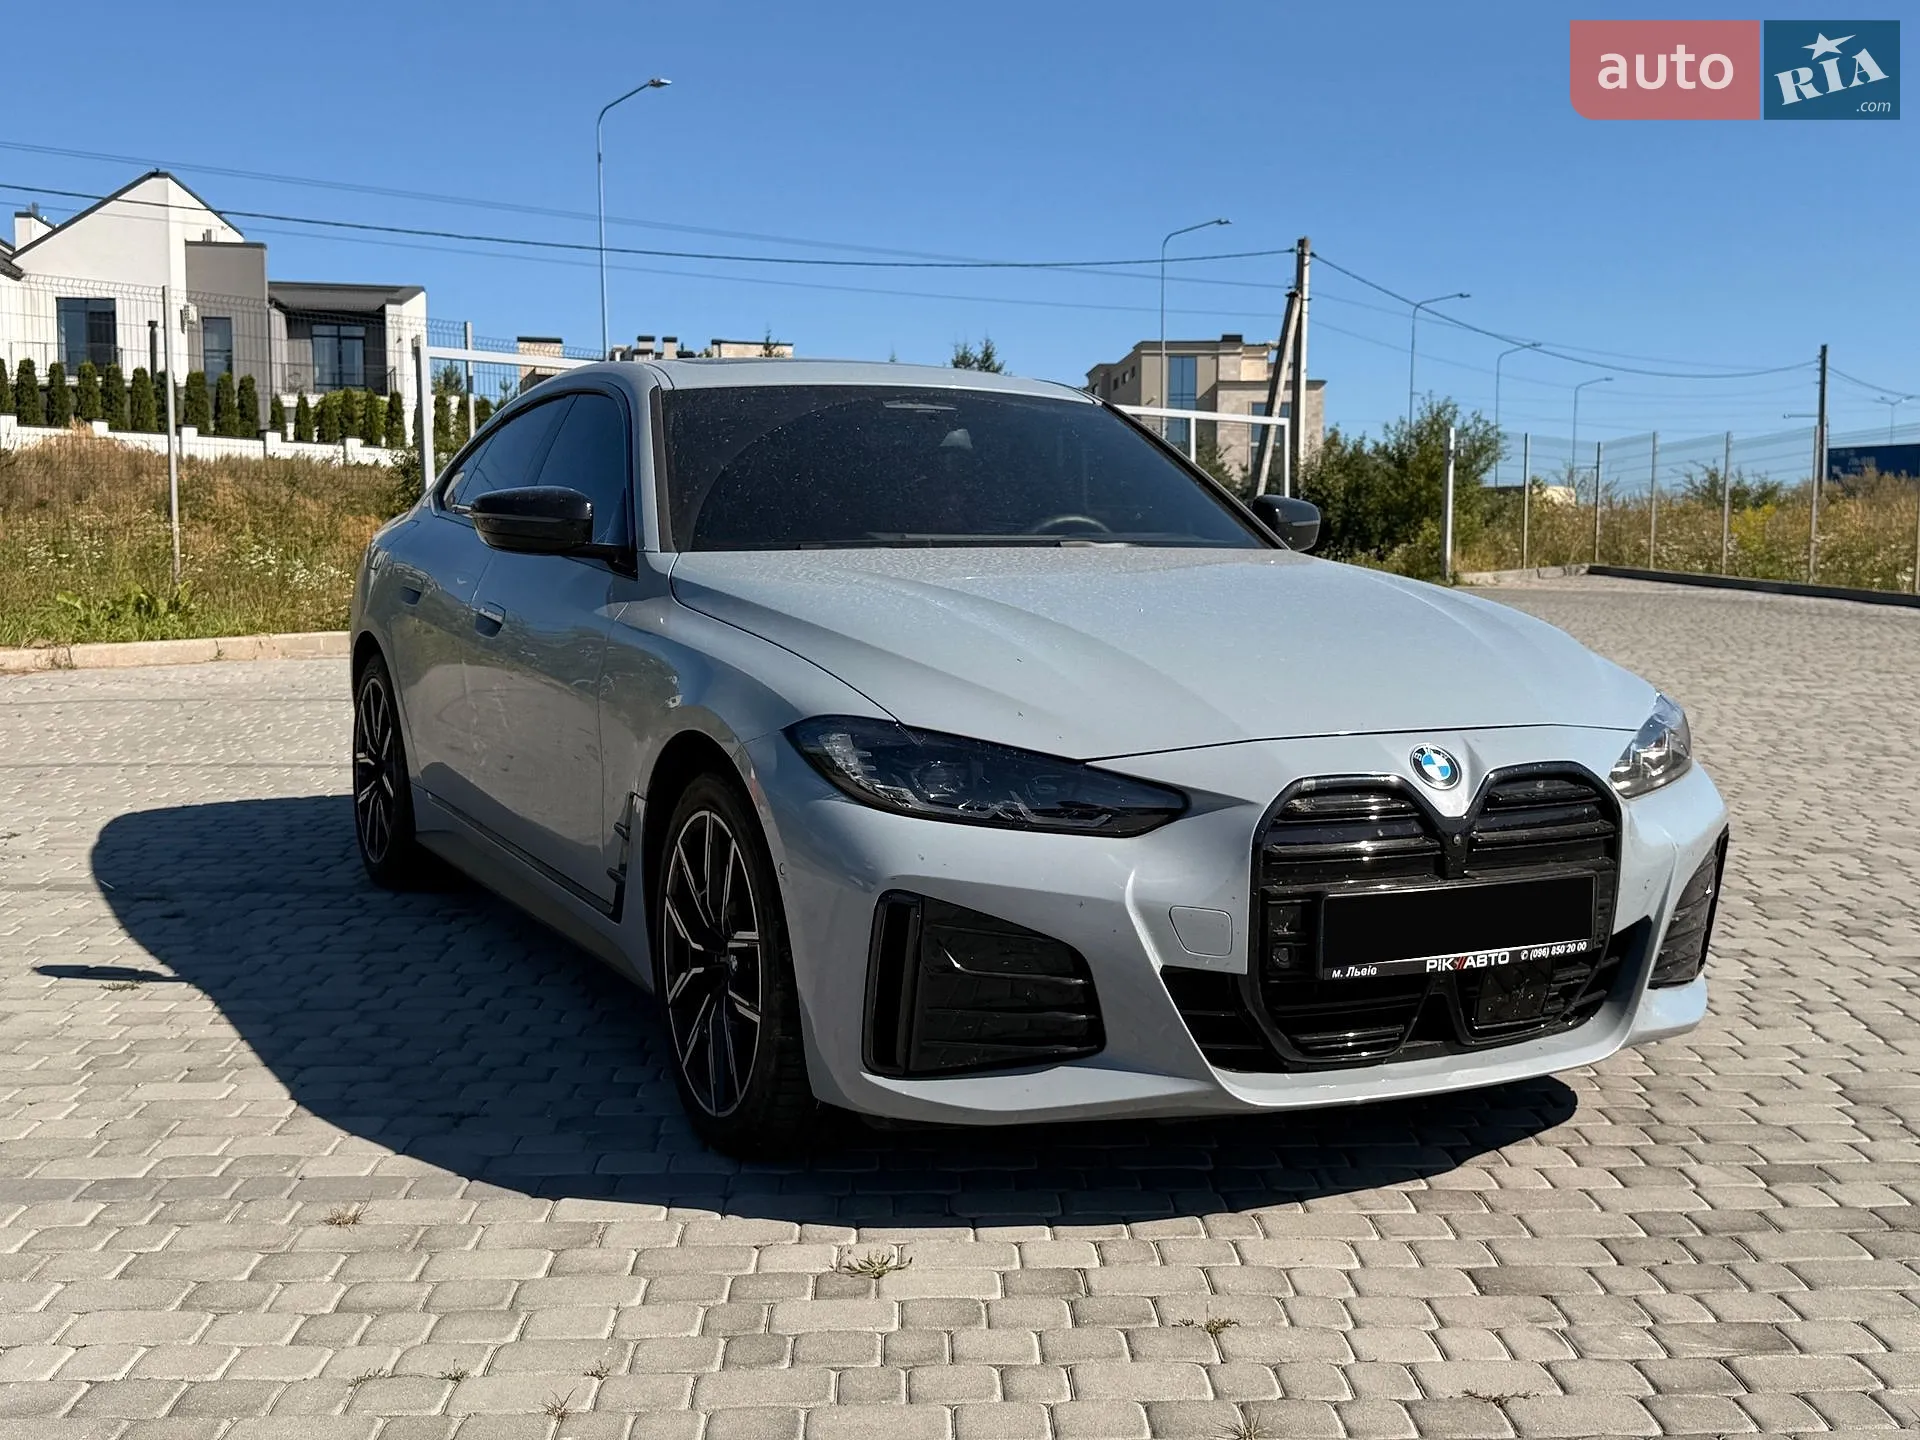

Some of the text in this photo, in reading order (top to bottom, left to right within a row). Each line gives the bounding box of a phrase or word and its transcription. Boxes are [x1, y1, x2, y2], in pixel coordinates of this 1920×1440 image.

[1551, 944, 1565, 955] 850
[1566, 943, 1576, 953] 20
[1577, 941, 1587, 952] 00
